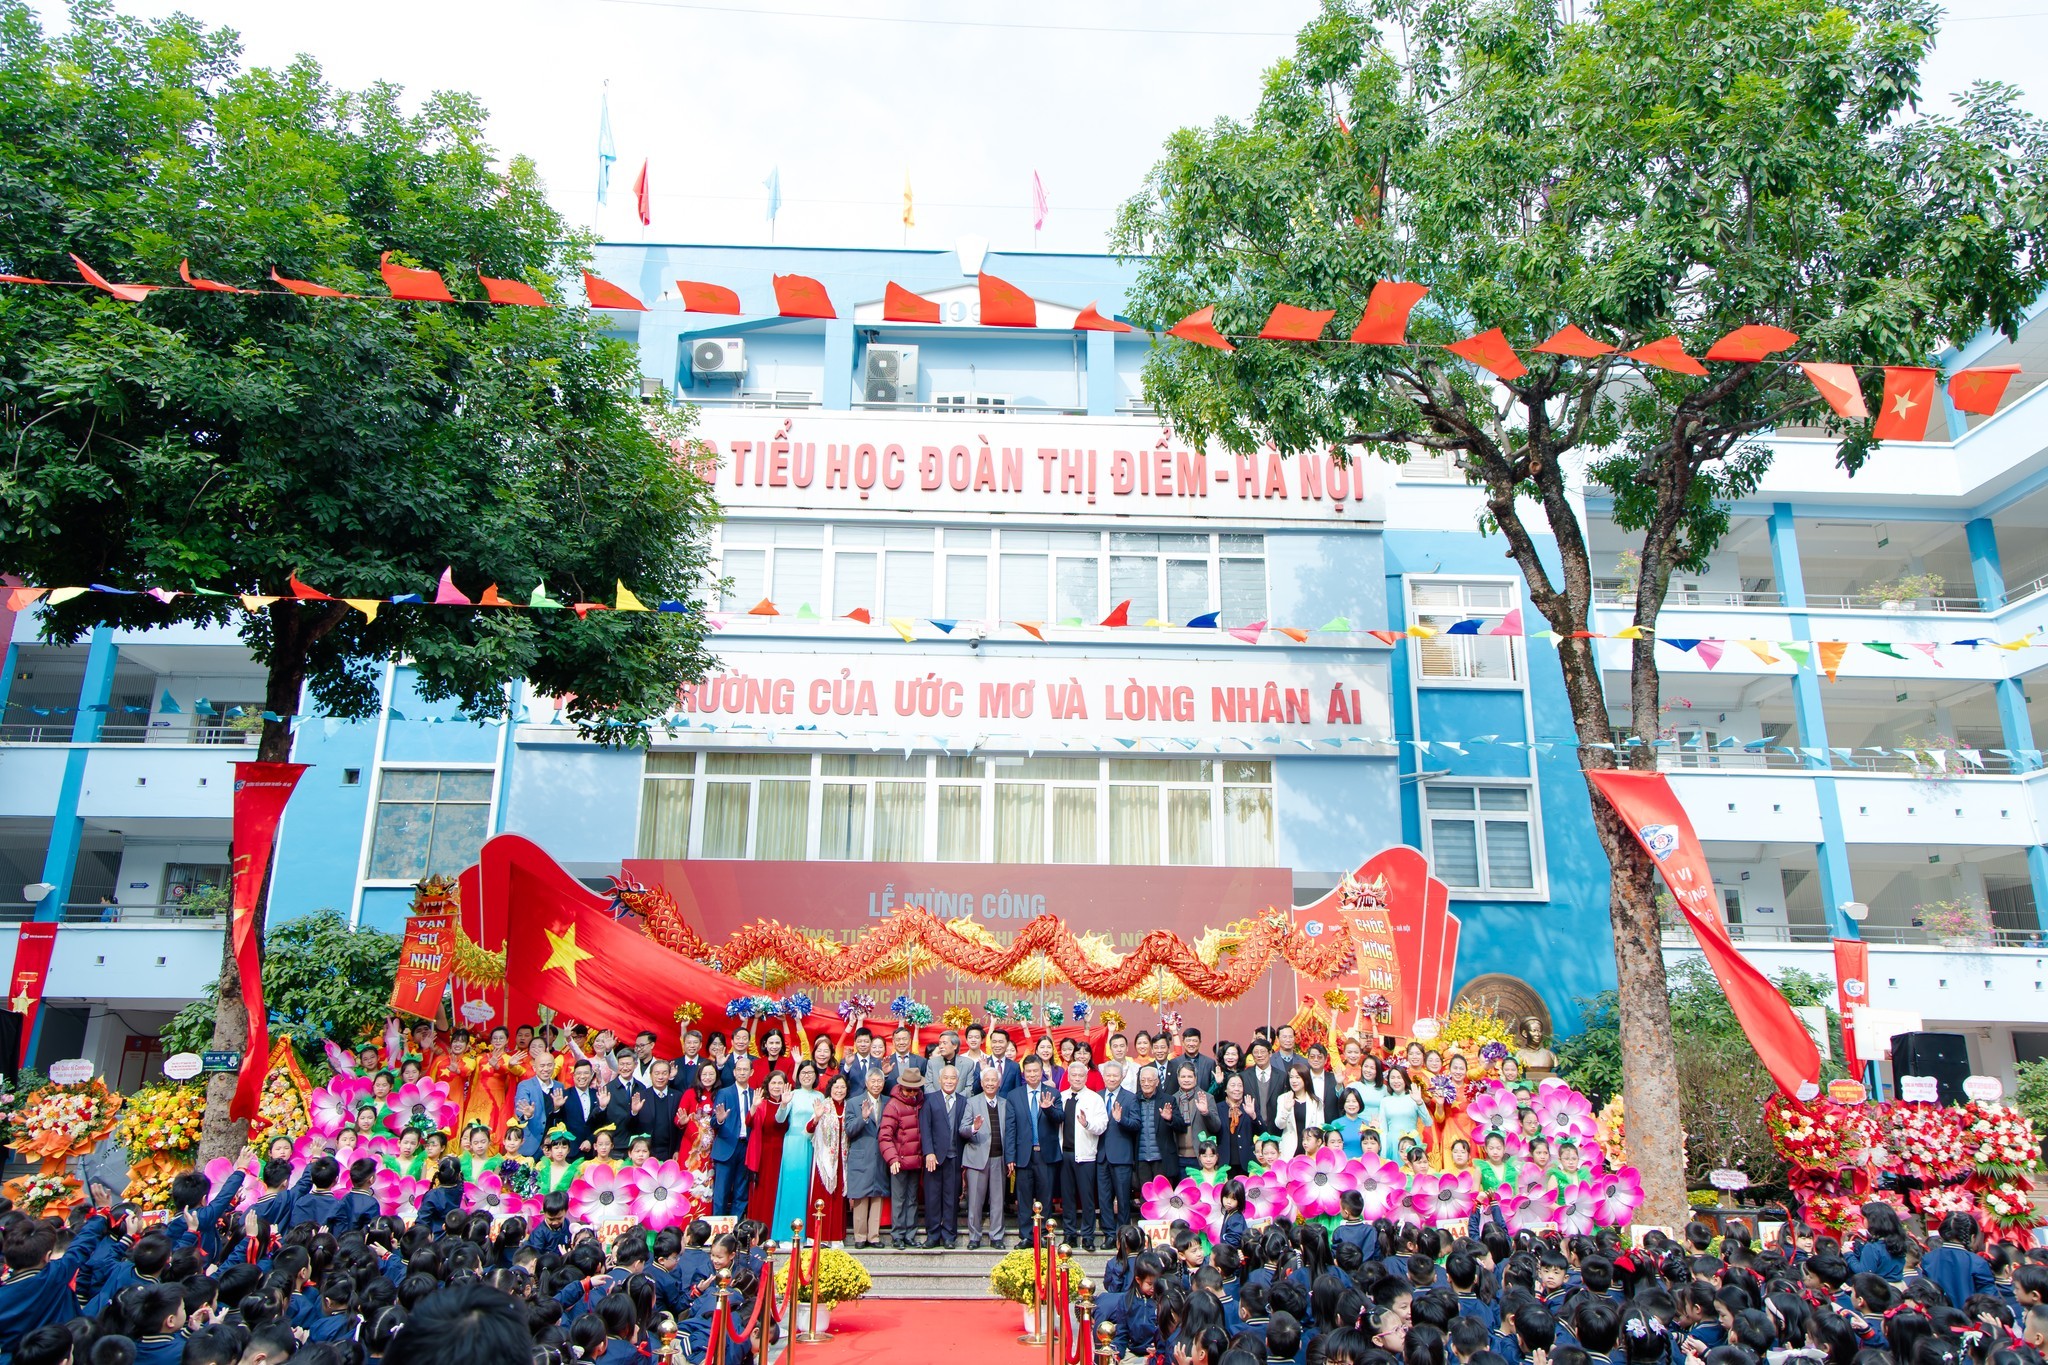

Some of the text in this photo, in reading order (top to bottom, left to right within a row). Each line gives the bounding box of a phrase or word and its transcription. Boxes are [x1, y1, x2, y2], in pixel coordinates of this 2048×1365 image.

[731, 418, 815, 488] TIỂU
[825, 443, 905, 499] HỌC
[919, 434, 1023, 493] ĐOÀN
[1037, 448, 1097, 504] THỊ
[674, 668, 795, 715] RƯỜNG
[809, 668, 878, 717] CỦA
[894, 672, 963, 717] ƯỚC
[980, 680, 1035, 720] MƠ
[1046, 677, 1088, 721] VÀ
[1105, 677, 1195, 723] LÒNG
[1212, 681, 1310, 724] NHÂN
[1327, 682, 1362, 725] ÁI
[868, 883, 895, 917] LỄ
[982, 889, 1046, 918] CÔNG
[417, 919, 446, 930] VẠN
[418, 932, 439, 948] SỰ
[1361, 940, 1394, 961] MỪNG
[410, 953, 443, 972] NHƯ
[1369, 967, 1394, 991] NĂM
[414, 978, 427, 1002] Ý
[943, 986, 981, 1005] NĂM
[711, 1224, 730, 1234] A8
[1147, 1228, 1168, 1240] 1A7
[1451, 1226, 1467, 1239] A4
